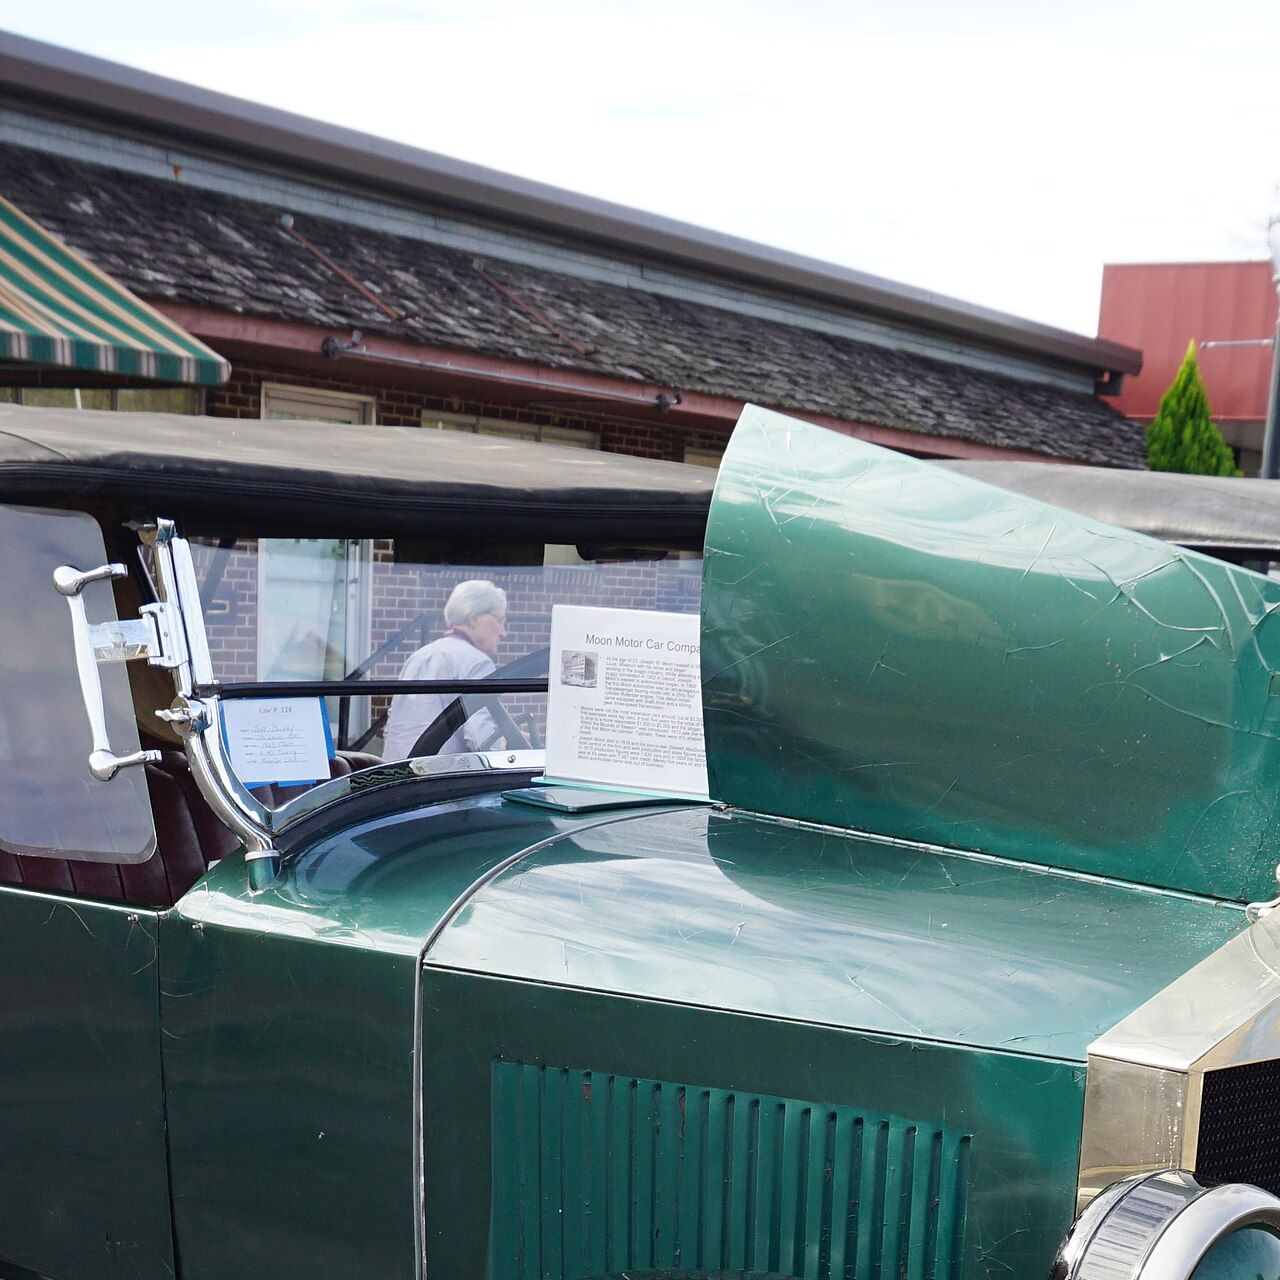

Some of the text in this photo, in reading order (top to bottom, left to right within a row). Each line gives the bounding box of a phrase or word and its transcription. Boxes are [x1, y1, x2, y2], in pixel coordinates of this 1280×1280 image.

[586, 634, 613, 646] Moon
[615, 636, 643, 648] Motor
[646, 638, 664, 650] Car
